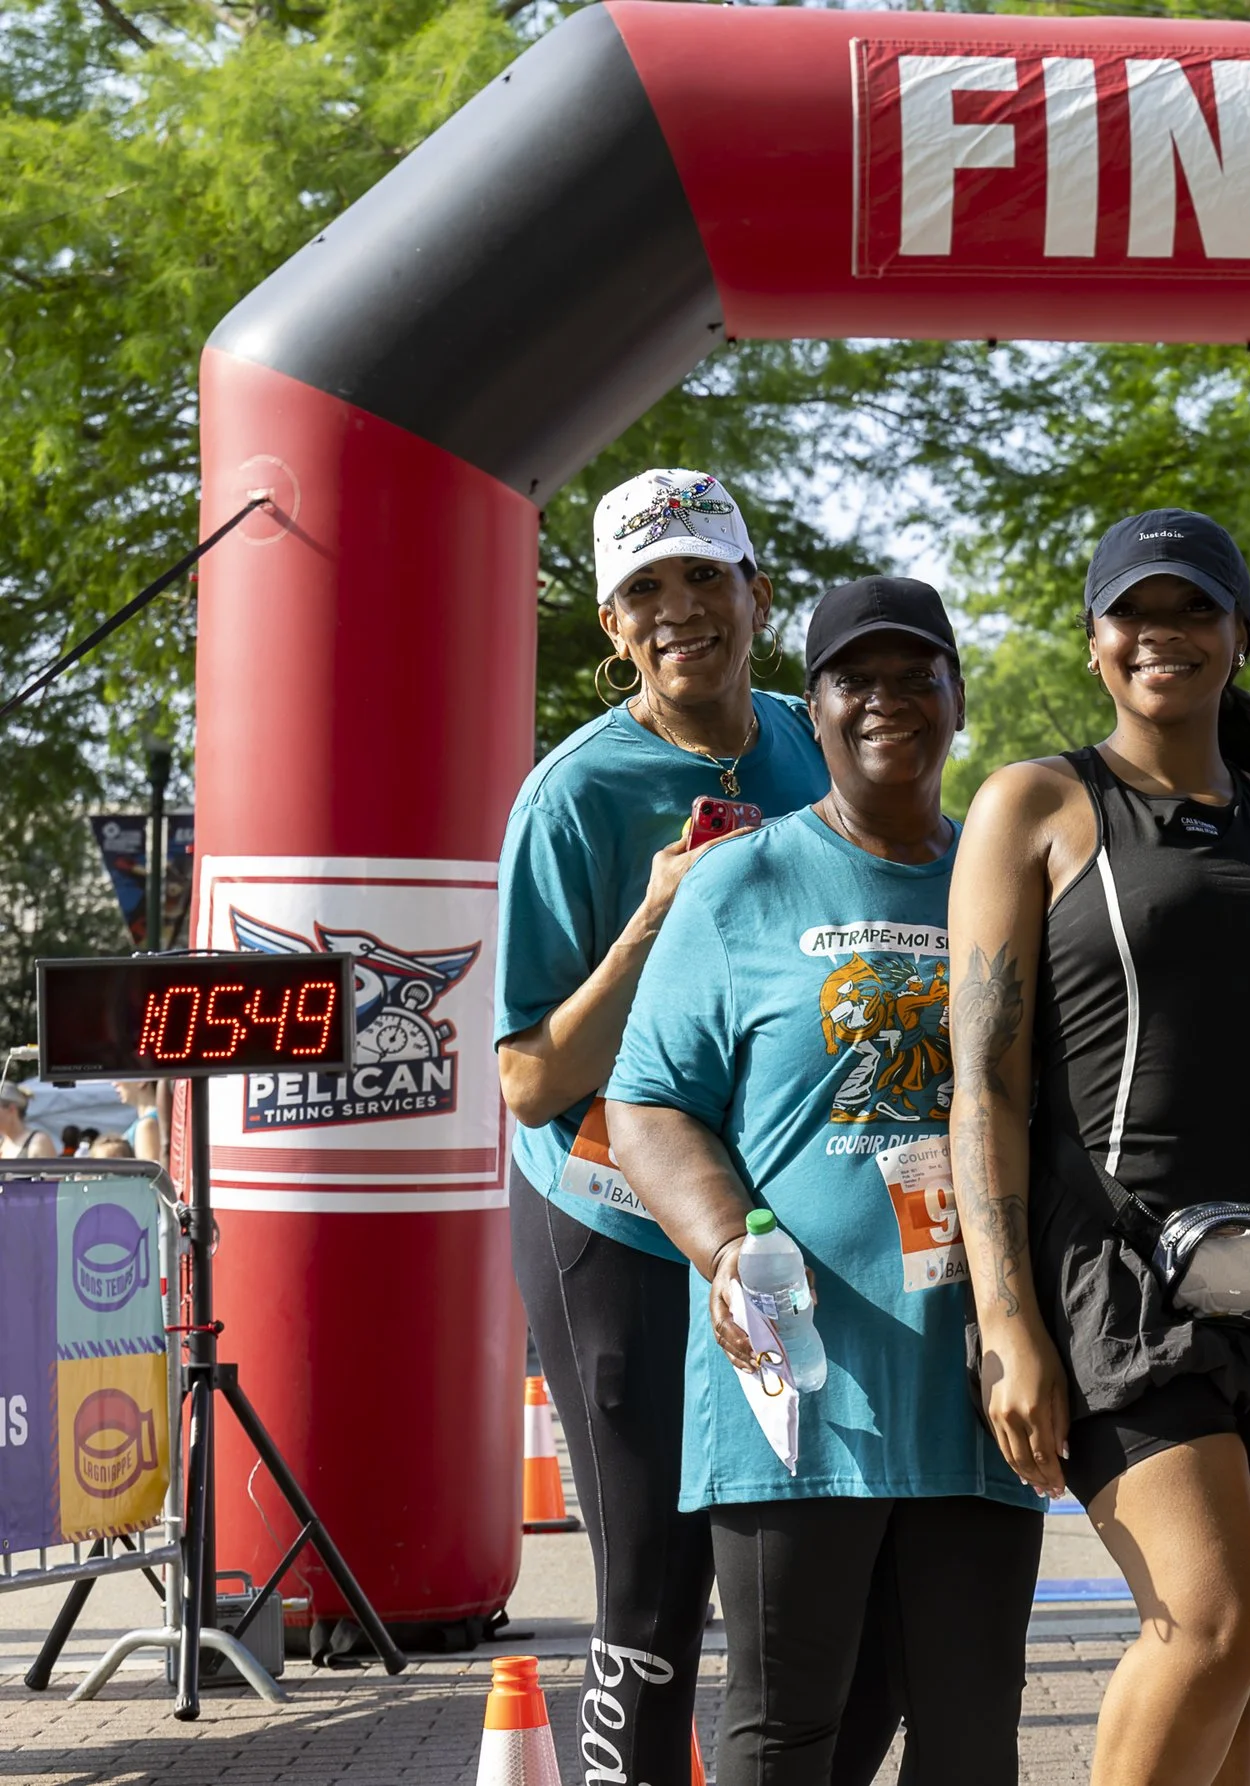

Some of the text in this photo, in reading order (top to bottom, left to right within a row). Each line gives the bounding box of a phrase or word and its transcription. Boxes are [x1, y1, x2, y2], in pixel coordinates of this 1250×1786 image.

[1139, 532, 1159, 541] Just
[1160, 530, 1173, 538] do
[812, 928, 929, 951] ATTRAPE-MOI
[249, 1060, 450, 1108] PELICAN
[264, 1095, 437, 1123] TIMING SERVICES
[826, 1135, 884, 1156] COURIR
[898, 1147, 939, 1165] Courir
[83, 1450, 132, 1483] LAGNIAPPE
